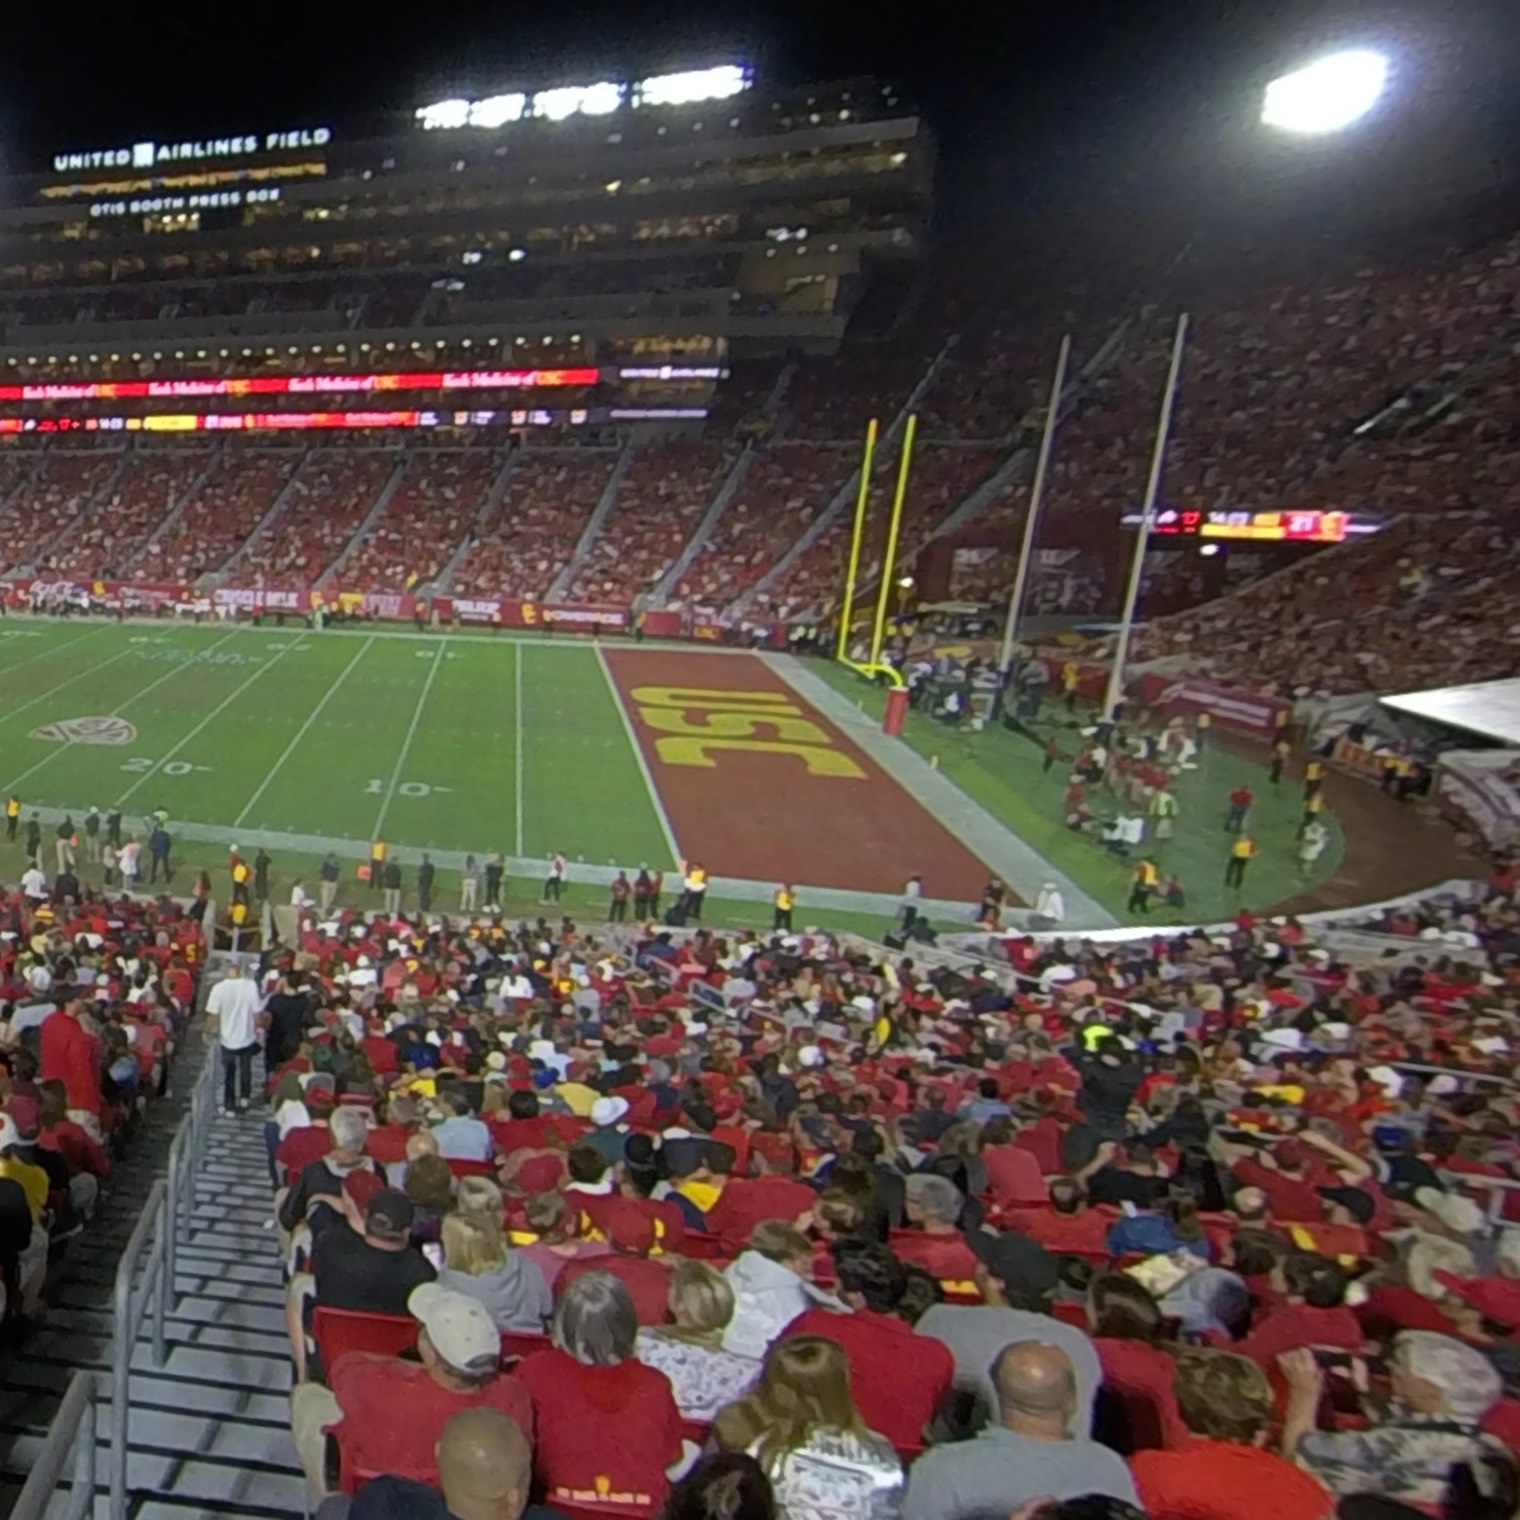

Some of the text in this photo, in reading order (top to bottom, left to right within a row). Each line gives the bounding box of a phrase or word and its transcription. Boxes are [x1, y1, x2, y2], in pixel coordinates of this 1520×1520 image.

[54, 128, 330, 171] UNITED AIRLINES FIELD
[90, 188, 280, 217] OTIS BOOTH PRESS BOX
[631, 686, 869, 779] USC
[120, 757, 194, 776] 20
[363, 778, 432, 797] 10
